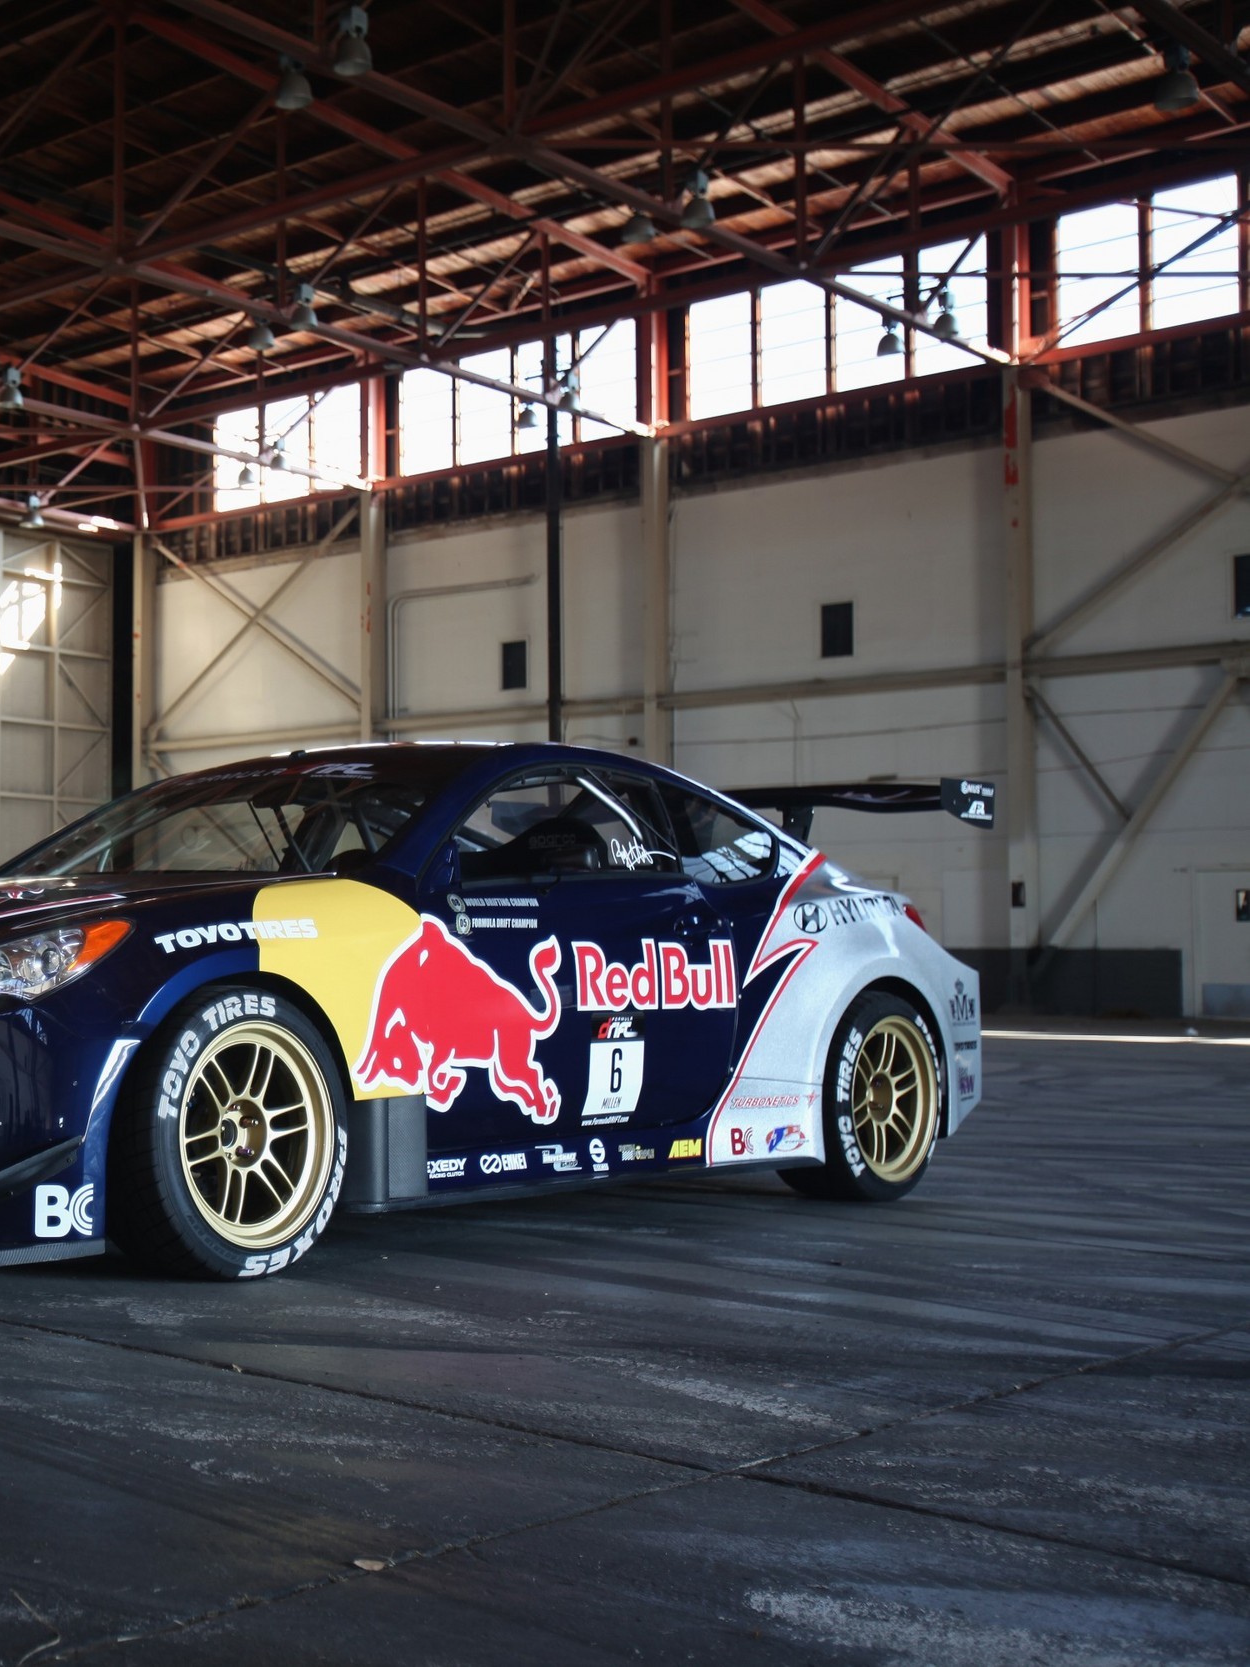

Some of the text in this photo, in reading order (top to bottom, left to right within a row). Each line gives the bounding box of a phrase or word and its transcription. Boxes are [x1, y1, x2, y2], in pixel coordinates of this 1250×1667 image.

[463, 898, 486, 907] WORLD
[484, 898, 511, 907] DRIFTING
[510, 898, 539, 907] CHAMPION
[471, 918, 496, 929] FORMULA
[496, 918, 511, 928] DRIFT
[511, 918, 538, 929] CHAMPION
[154, 919, 319, 954] TOYO TIRES
[571, 938, 737, 1012] Red Bull
[158, 994, 276, 1120] TOYO TIRES
[609, 1047, 623, 1094] 6
[600, 1097, 622, 1110] MILLEN
[730, 1095, 800, 1110] TURBONETICS
[837, 1027, 866, 1178] TOYO TIRES
[668, 1138, 702, 1159] AEM
[446, 1170, 465, 1178] CLUTCH
